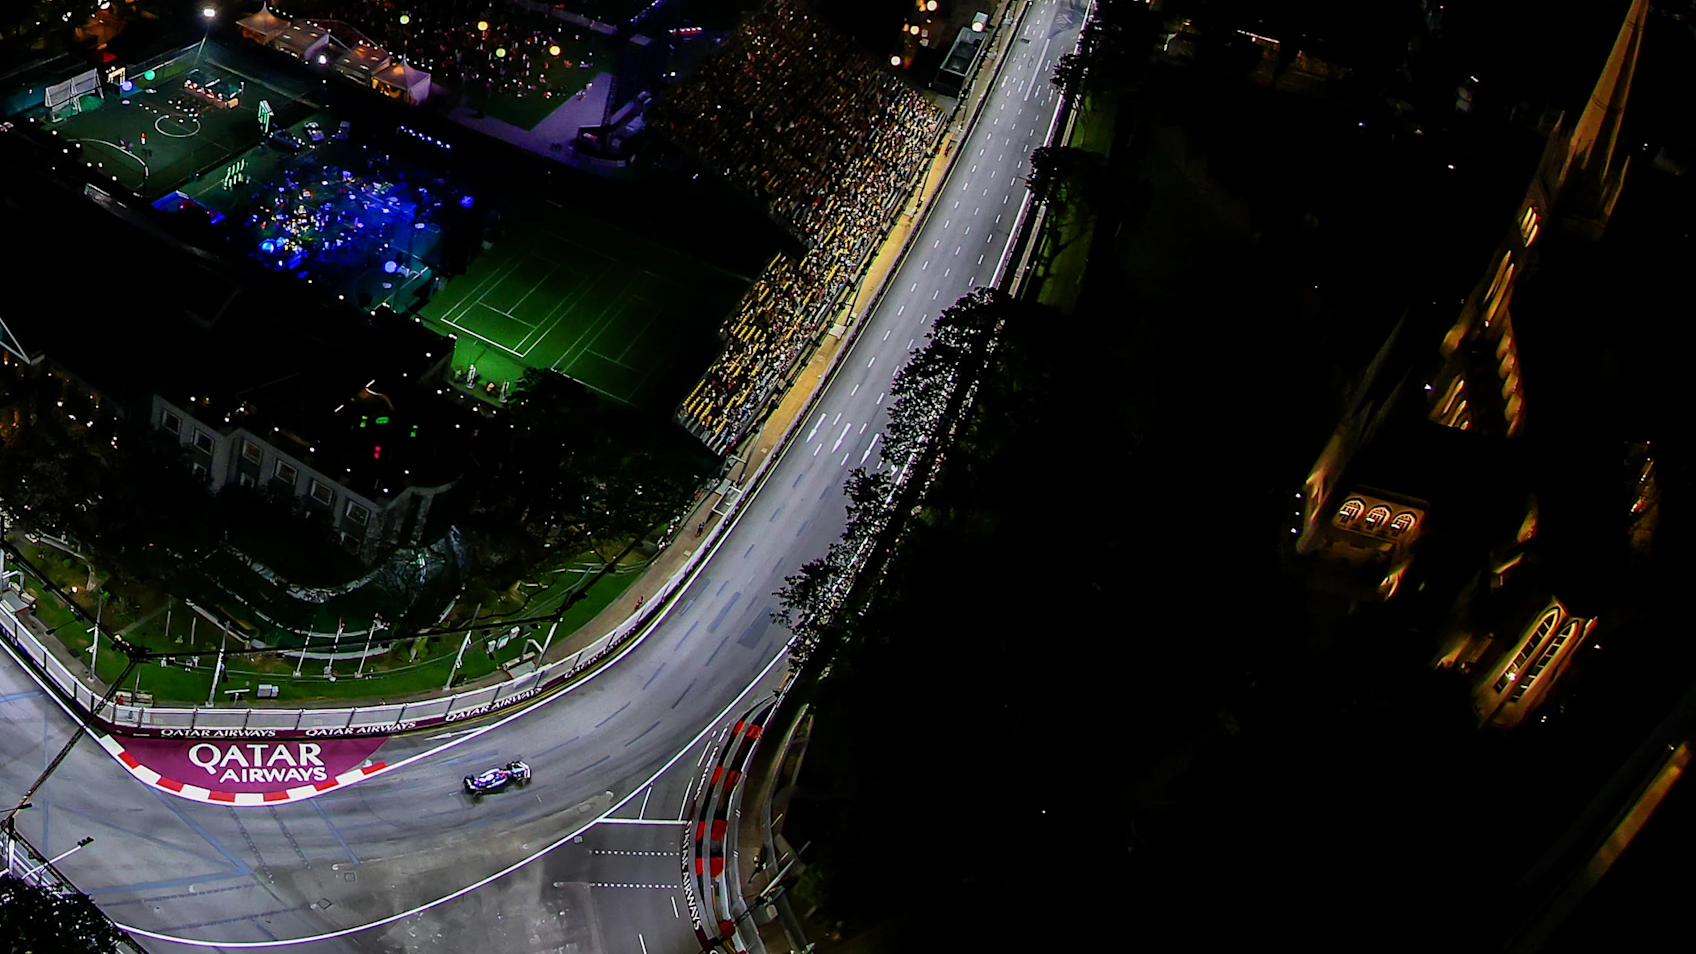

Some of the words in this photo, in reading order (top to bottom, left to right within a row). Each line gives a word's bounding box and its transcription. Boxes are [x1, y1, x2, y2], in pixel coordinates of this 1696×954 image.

[445, 705, 490, 722] QATAR
[491, 687, 543, 711] AIRWAYS
[161, 728, 213, 737] QATAR
[215, 729, 276, 738] AIRWAYS
[305, 727, 354, 737] QATAR
[356, 721, 416, 734] AIRWAYS
[188, 743, 324, 774] QATAR
[219, 767, 327, 783] AIRWAYS
[681, 820, 693, 870] QATAR
[681, 871, 703, 930] AIRWAYS
